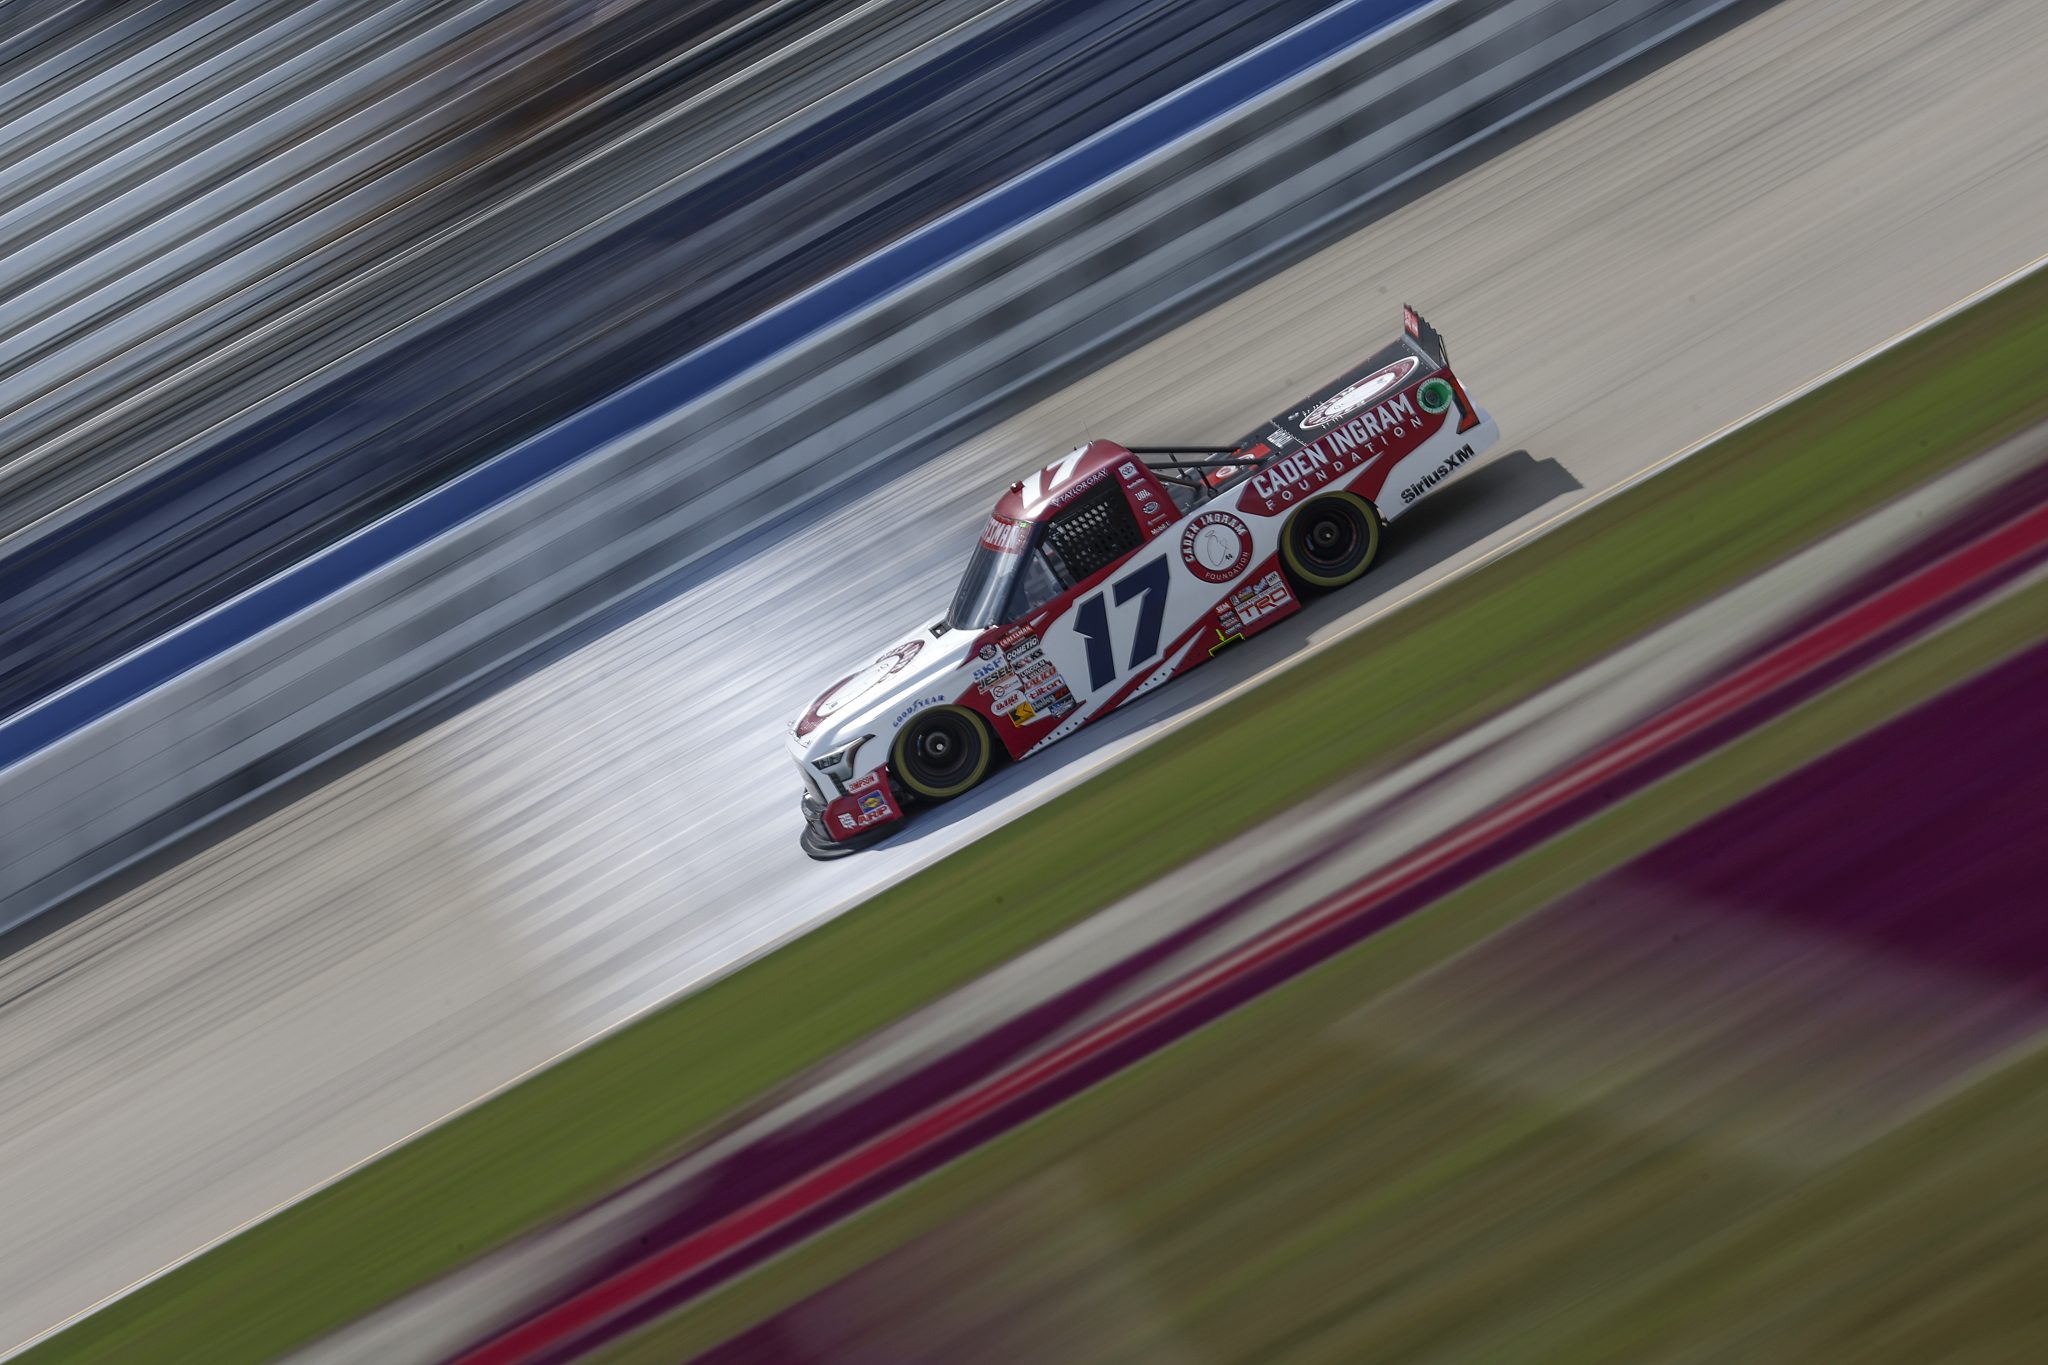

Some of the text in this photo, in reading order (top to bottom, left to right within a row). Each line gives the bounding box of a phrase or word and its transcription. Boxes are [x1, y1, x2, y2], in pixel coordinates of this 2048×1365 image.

[1251, 443, 1330, 499] CADEN
[1325, 392, 1417, 457] INGRAM
[1265, 416, 1424, 511] FOUNDATION
[1400, 443, 1475, 504] SiriusXM
[1183, 513, 1248, 562] CADEN INGRAM
[1205, 551, 1250, 580] FOUNDATION
[1238, 587, 1288, 617] TRD
[1073, 552, 1170, 693] 17
[1006, 637, 1037, 660] COMETIC
[973, 656, 1003, 681] SKF
[979, 665, 1014, 690] JESEL
[1029, 678, 1062, 700] tilton
[892, 695, 945, 728] GOODYEAR
